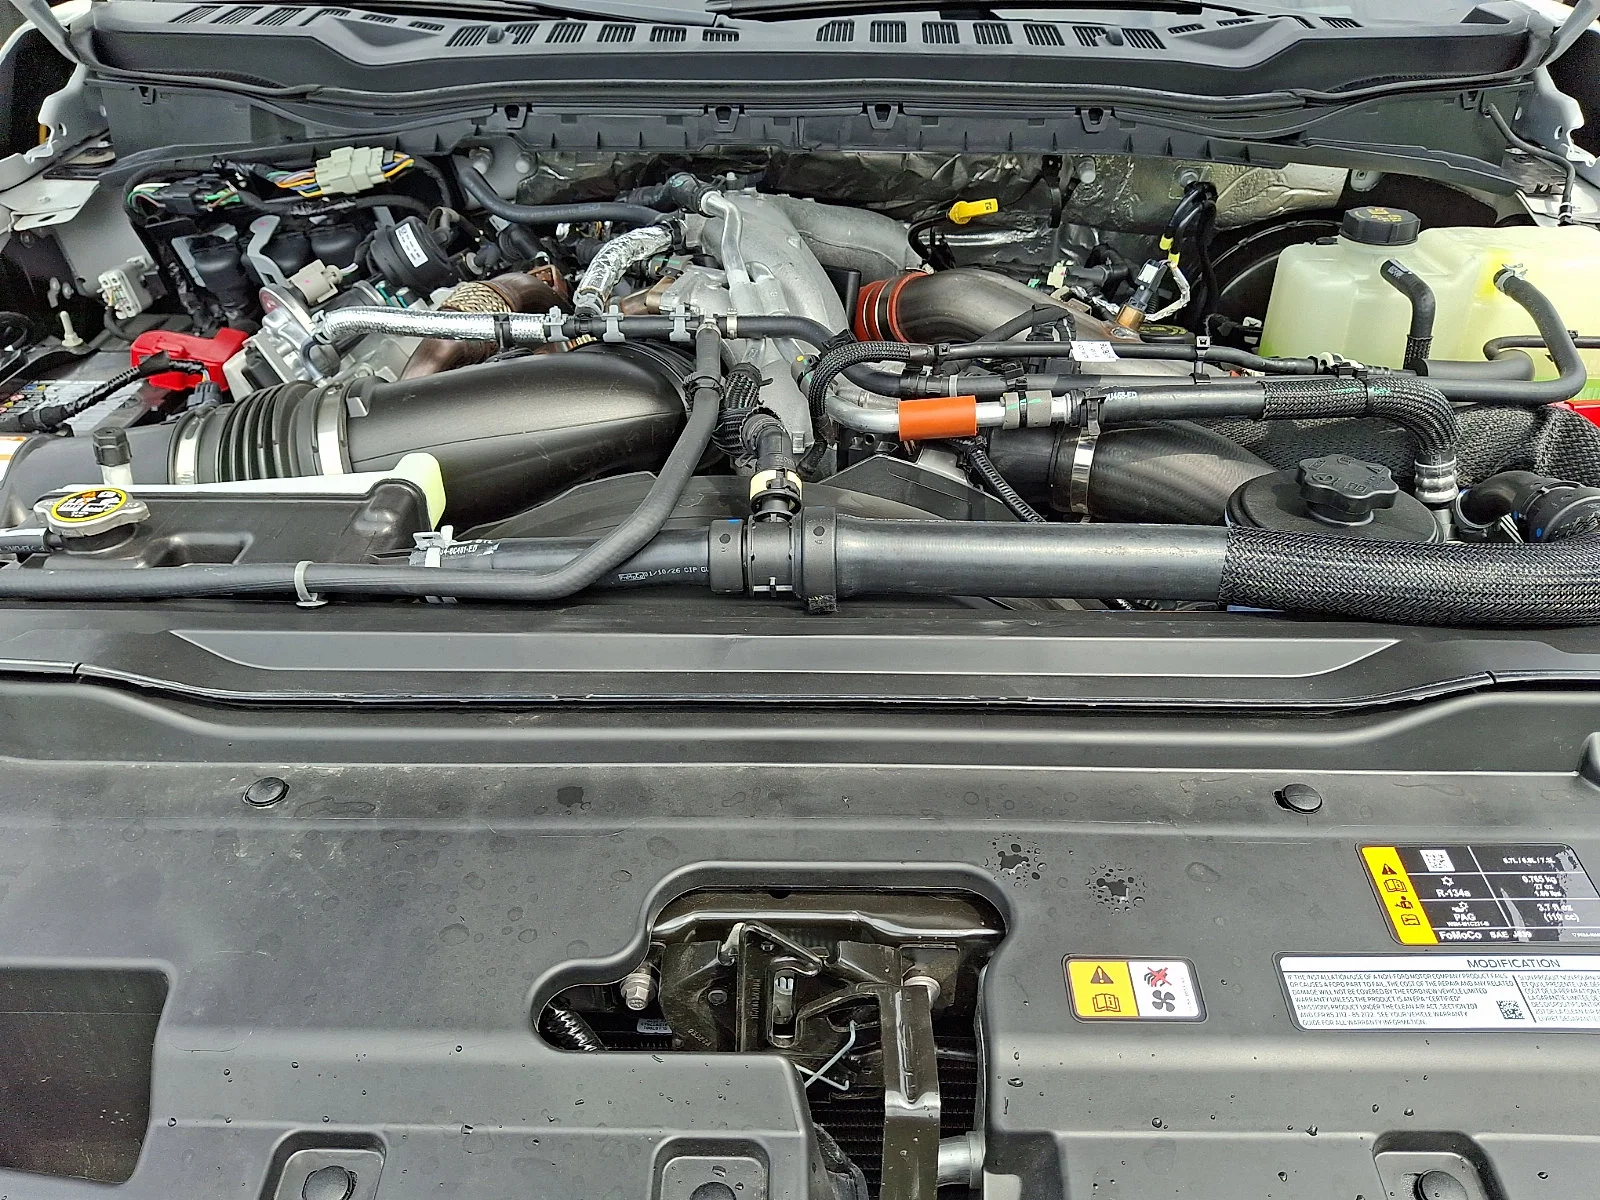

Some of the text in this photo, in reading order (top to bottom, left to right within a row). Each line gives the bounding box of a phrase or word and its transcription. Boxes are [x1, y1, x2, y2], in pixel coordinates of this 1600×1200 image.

[1544, 875, 1557, 884] kg
[1435, 889, 1471, 898] R-134a
[1537, 904, 1551, 912] 3.7
[1453, 913, 1476, 921] PAG
[1543, 912, 1579, 922] (110 cc)
[1439, 931, 1482, 940] FoMoCo
[1466, 958, 1561, 968] MODIFICATION
